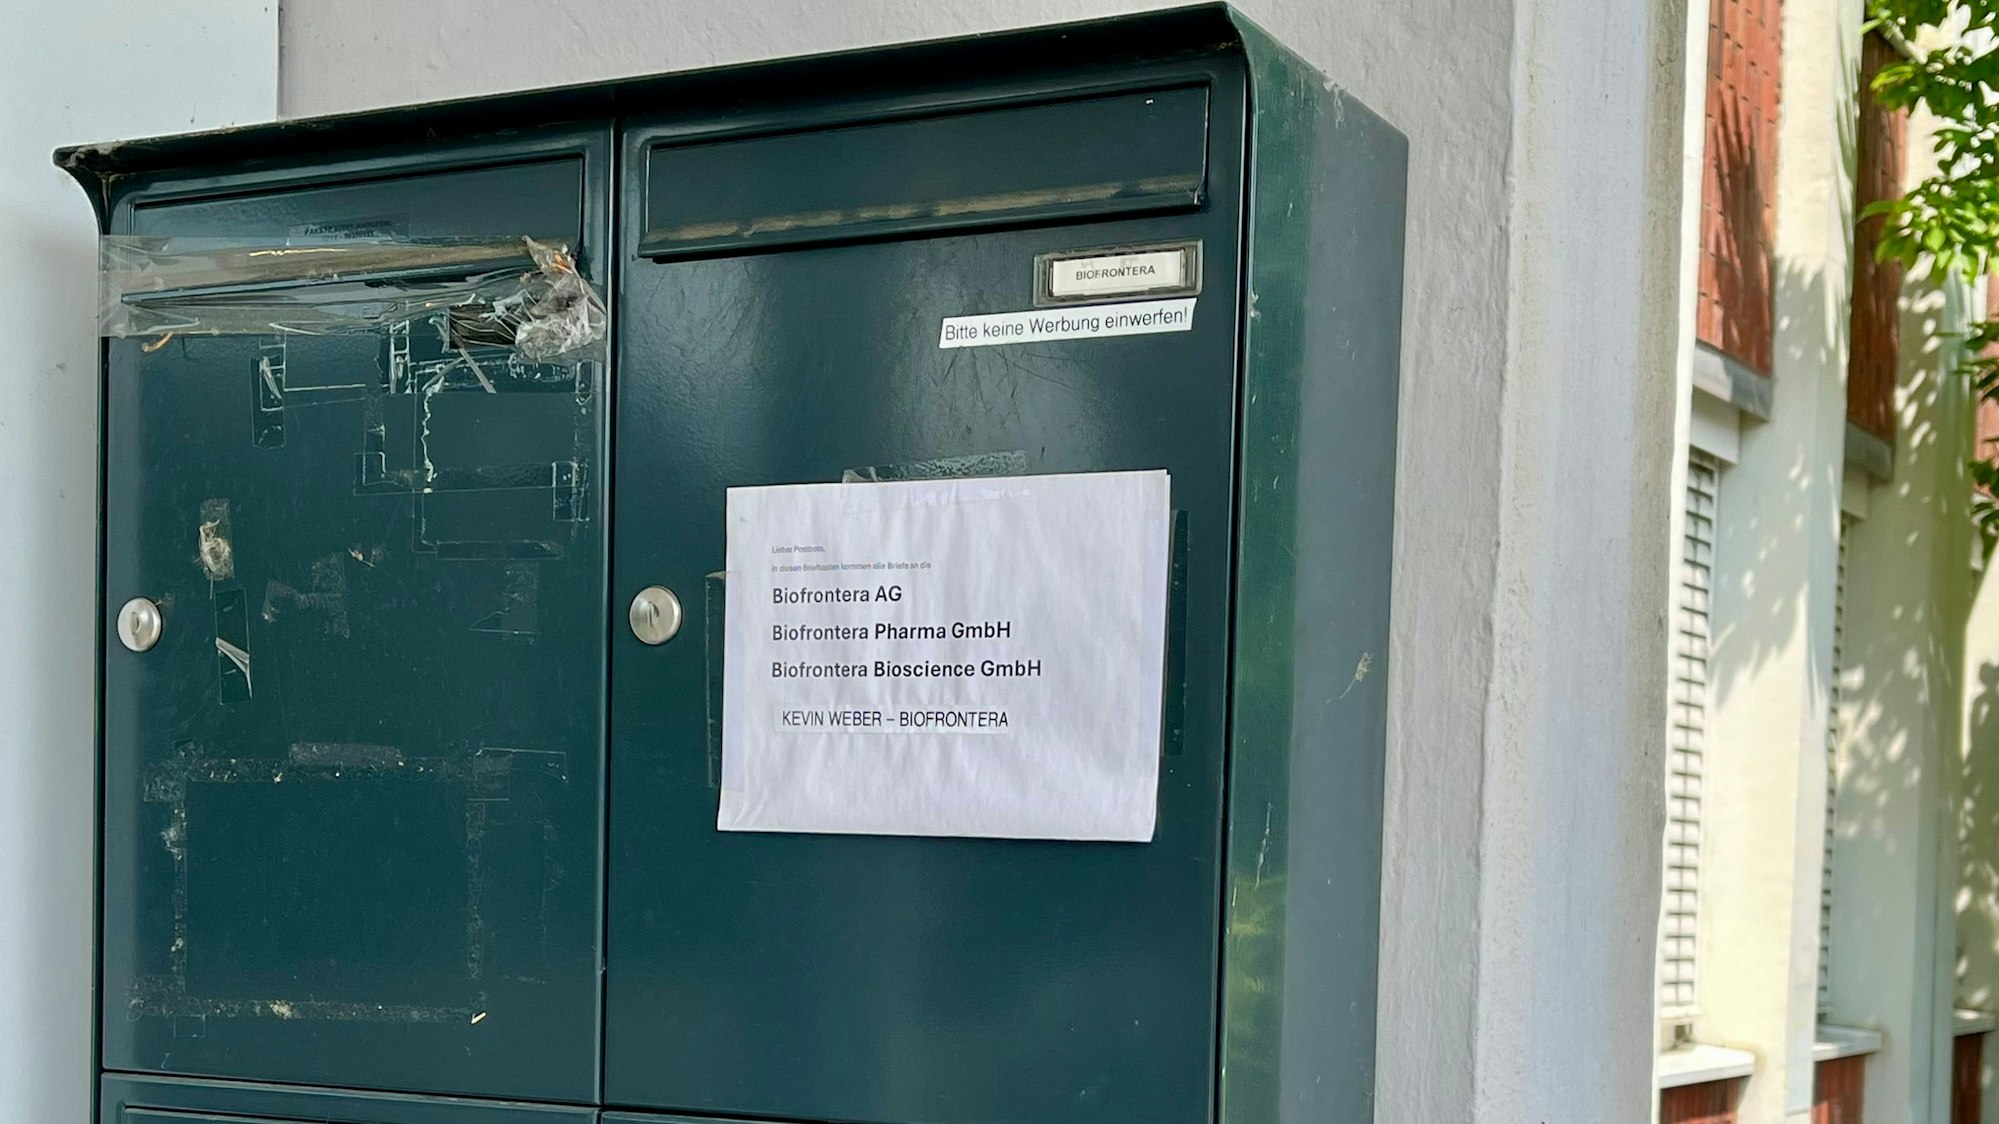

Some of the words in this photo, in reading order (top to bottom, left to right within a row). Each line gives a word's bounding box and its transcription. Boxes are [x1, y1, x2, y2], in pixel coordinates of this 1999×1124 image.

[1075, 264, 1156, 281] BIOFRONTERA
[944, 324, 978, 341] Bitte
[983, 322, 1024, 338] keine
[1029, 316, 1100, 335] Werbung
[1105, 307, 1187, 330] einwerfen!
[772, 588, 869, 604] Biofrontera
[875, 586, 902, 602] AG
[772, 624, 868, 640] Biofrontera
[875, 623, 946, 639] Pharma
[952, 621, 1011, 638] GmbH
[772, 661, 868, 677] Biofrontera
[874, 661, 975, 677] Bioscience
[981, 660, 1041, 677] GmbH
[782, 711, 823, 726] KEVIN
[829, 711, 882, 726] WEBER
[899, 711, 1008, 727] BIOFRONTERA
